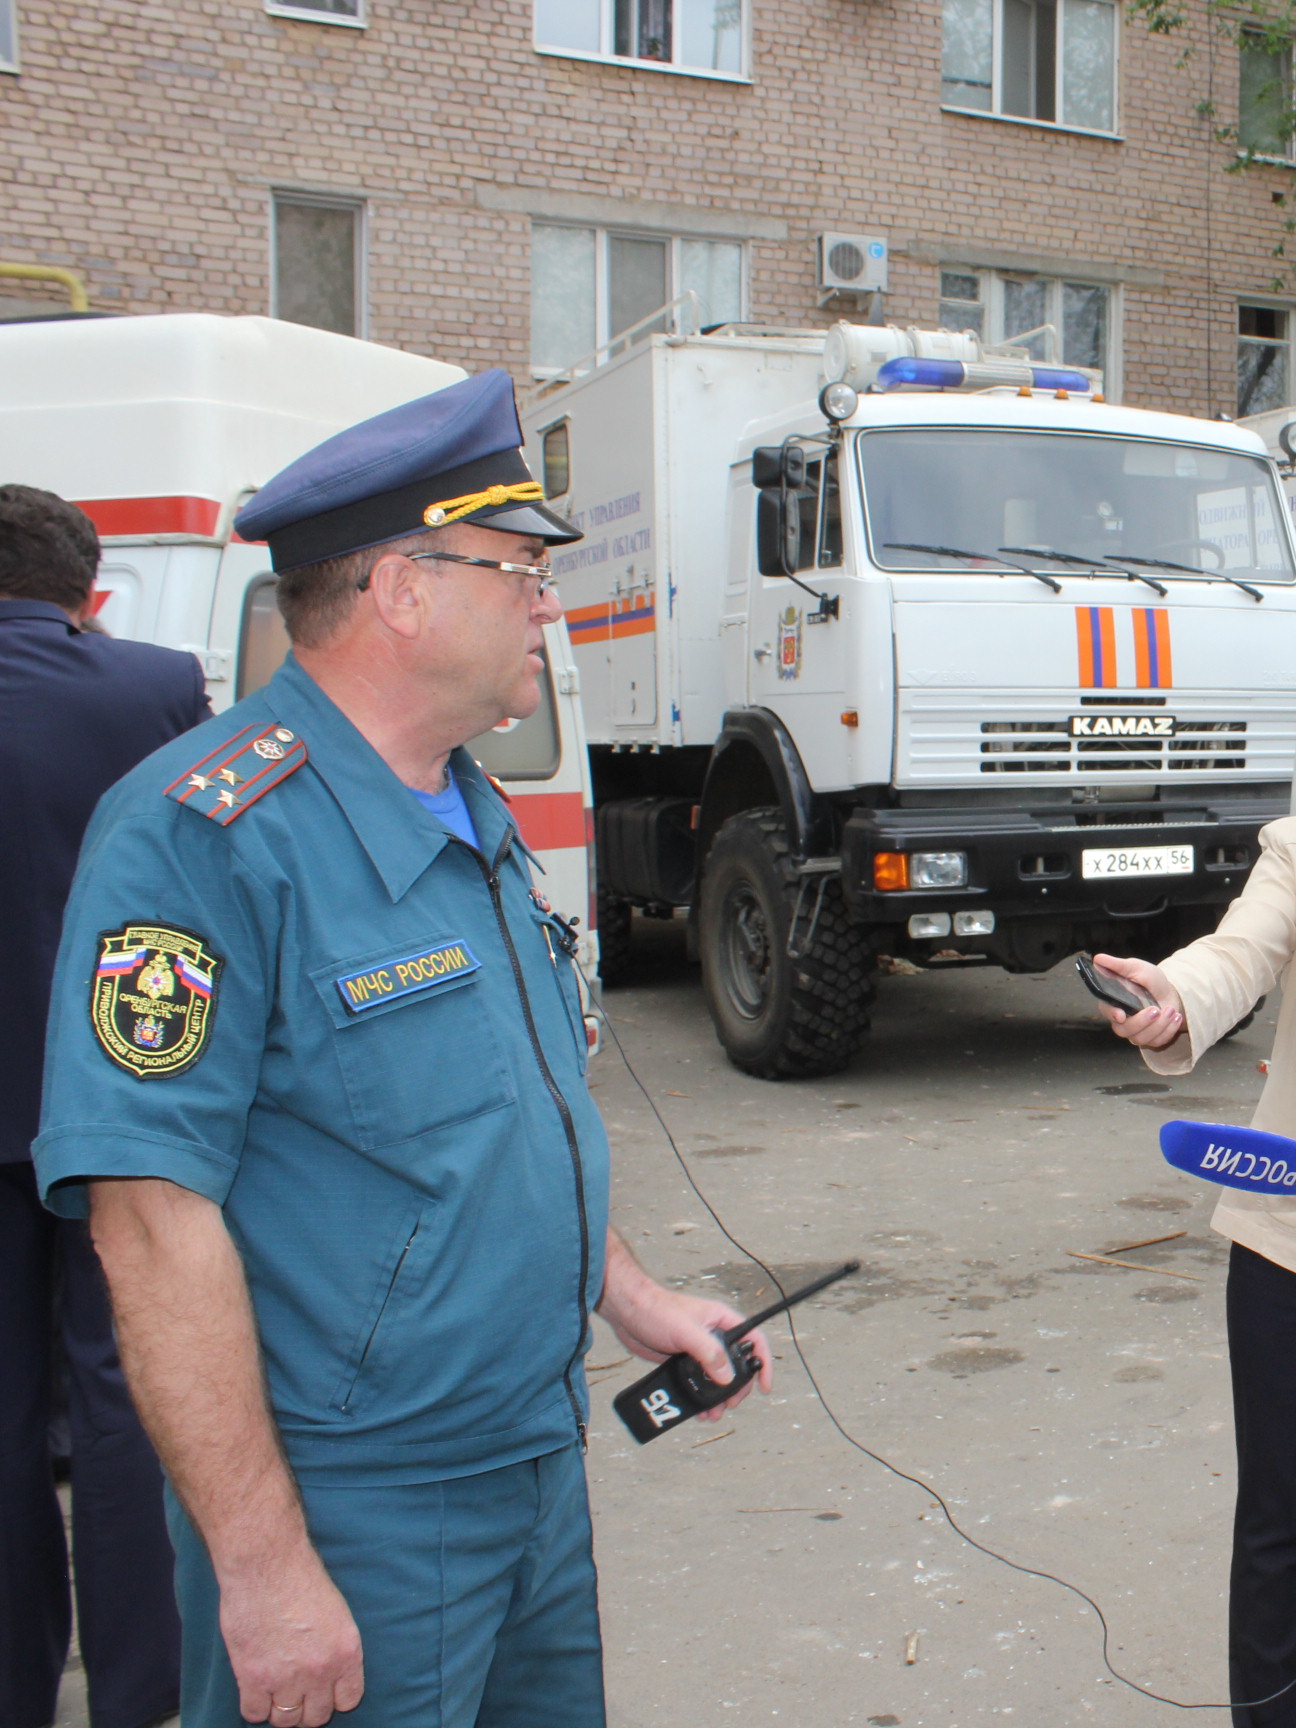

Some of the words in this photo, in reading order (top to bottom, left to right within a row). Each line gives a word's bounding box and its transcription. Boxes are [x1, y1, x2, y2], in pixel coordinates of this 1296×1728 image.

[613, 528, 650, 559] ОБЛАСТИ
[1072, 717, 1174, 735] KAMAZ
[1171, 850, 1189, 865] 56
[346, 970, 393, 1003] МЧС
[395, 946, 469, 986] РОССИИ
[119, 993, 187, 1014] ОРЕНБУРГСКАЯ
[131, 1004, 173, 1019] ОБЛАСТЬ
[98, 982, 128, 1056] ПРИВОЛЖСКИЙ
[126, 1033, 199, 1066] РЕГИОНАЛЬНЫЙ
[190, 999, 205, 1034] ЦЕНТР
